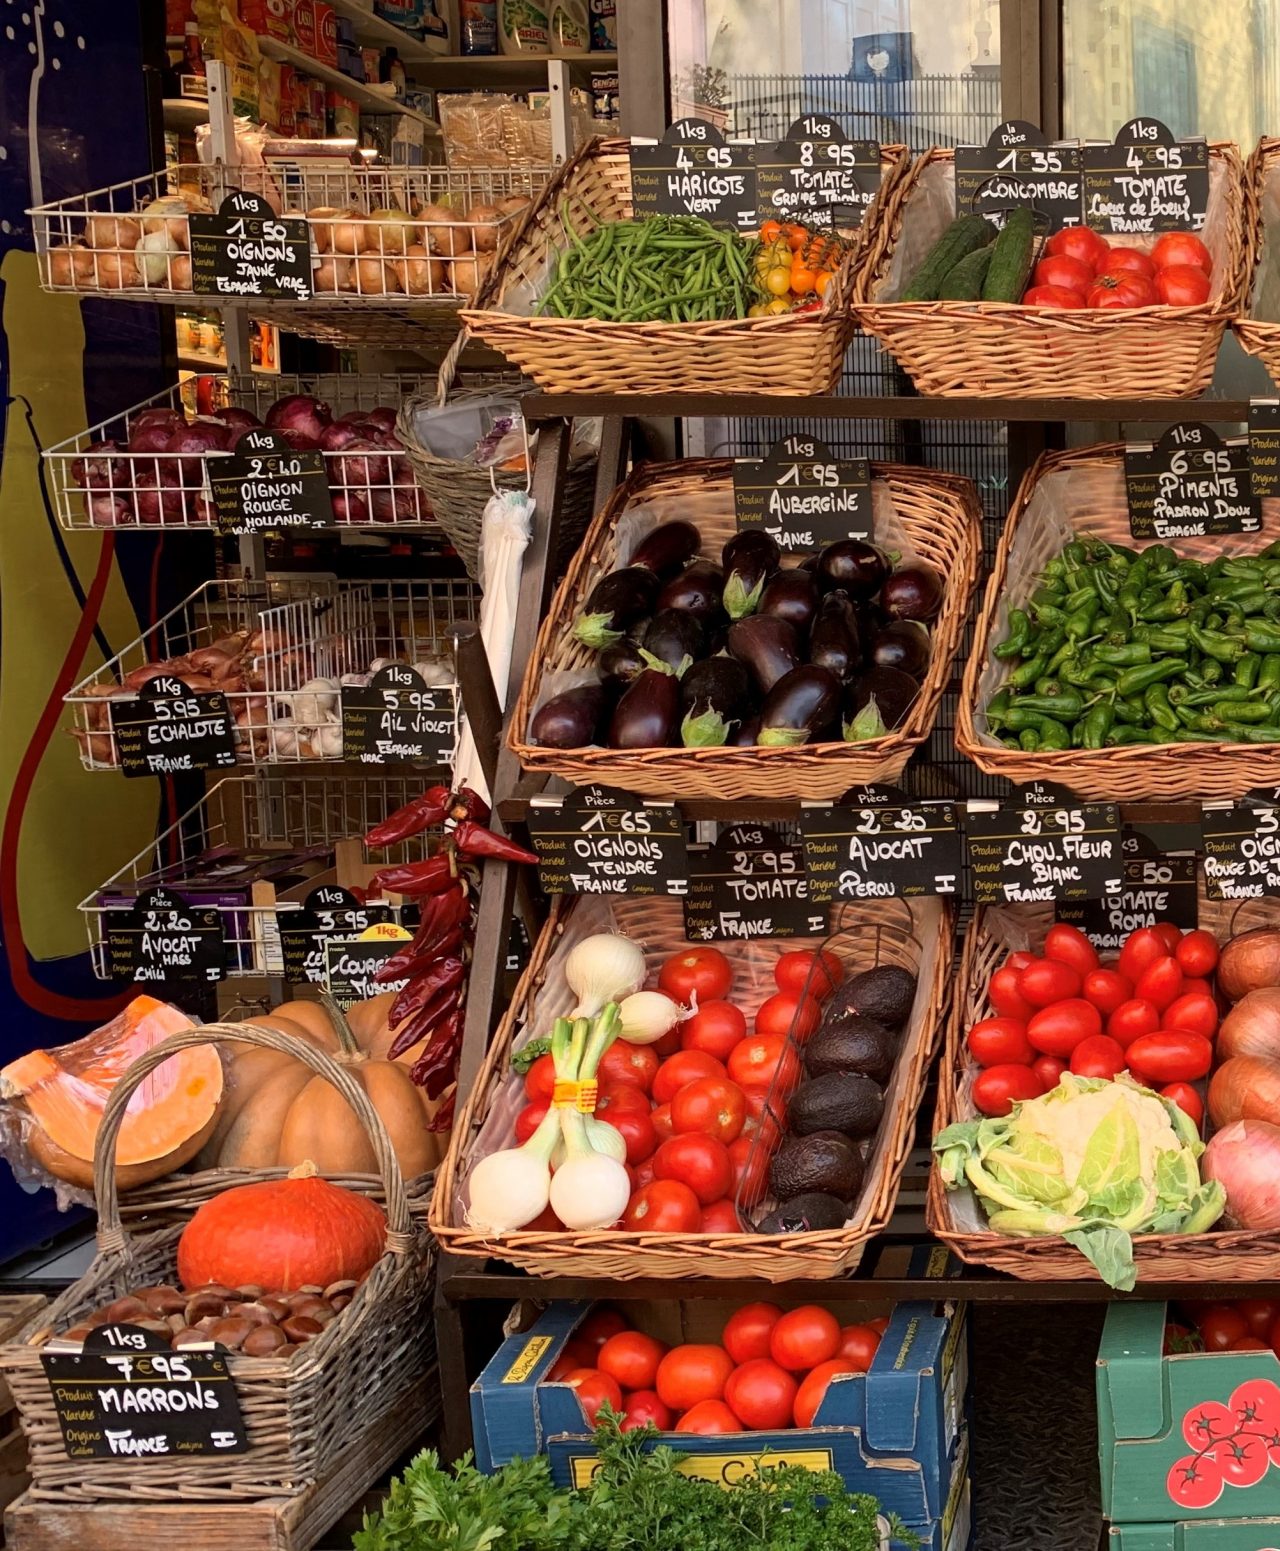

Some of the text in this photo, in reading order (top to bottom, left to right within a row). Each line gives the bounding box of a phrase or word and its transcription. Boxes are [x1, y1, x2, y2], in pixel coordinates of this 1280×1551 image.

[518, 28, 549, 41] ARIEL
[677, 122, 706, 140] 1kg
[803, 119, 831, 136] 1kg
[1007, 123, 1016, 134] la
[1130, 121, 1158, 140] 1kg
[1002, 133, 1026, 145] Pièce
[668, 171, 745, 197] HARICOTS
[790, 168, 853, 189] TOMATE
[980, 173, 1079, 200] CONCOMBRE
[1114, 174, 1187, 198] TOMATE
[231, 194, 259, 212] 1kg
[684, 198, 721, 213] VERT
[1130, 198, 1146, 215] de
[1110, 216, 1154, 232] FRANCE
[227, 239, 296, 262] OIGNONS
[236, 262, 276, 282] JAUNE
[216, 276, 306, 295] ESPAGNE VRAC
[246, 432, 274, 449] 1kg
[1171, 426, 1202, 444] 1kg
[784, 437, 815, 457] 1kg
[241, 481, 303, 501] OIGNON
[1159, 471, 1239, 499] PIMENTS
[242, 499, 292, 514] ROUGE
[769, 488, 858, 523] AUBERGINE
[1153, 497, 1251, 520] PADRON DOUX
[245, 514, 312, 528] HOLLANDE
[1154, 521, 1206, 539] ESPAGNE
[232, 526, 258, 535] VRAC
[386, 667, 412, 685] 1kg
[147, 719, 226, 744] ECHALOTE
[381, 711, 455, 738] AIL VIOLET
[360, 754, 385, 763] VRAC
[376, 740, 423, 759] ESPAGNE
[147, 754, 193, 772] FRANCE
[591, 787, 602, 796] la
[865, 786, 875, 794] la
[1034, 782, 1044, 794] la
[585, 796, 616, 806] Pièce
[858, 794, 888, 804] Pièce
[1026, 792, 1055, 804] Pièce
[730, 828, 764, 845] 1kg
[574, 833, 663, 860] OIGNONS
[849, 836, 933, 871] AVOCAT
[588, 860, 657, 875] TENDRE
[1204, 856, 1246, 877] ROUGE
[1249, 859, 1270, 875] DE
[540, 873, 627, 894] Origine FRANCE
[726, 879, 808, 901] TOMATE
[839, 870, 895, 897] PEROU
[1003, 882, 1057, 902] FRANCE
[1219, 879, 1264, 899] FRANCE
[150, 897, 172, 907] Pièce
[157, 888, 164, 898] la
[316, 888, 344, 904] 1kg
[719, 911, 774, 939] FRANCE
[1109, 910, 1156, 931] ROMA
[376, 926, 398, 938] 1kg
[142, 932, 202, 960] AVOCAT
[163, 954, 192, 965] HASS
[102, 1327, 146, 1350] 1kg
[56, 1381, 219, 1413] Produit MARRONS
[66, 1429, 169, 1457] Origine FRANCE
